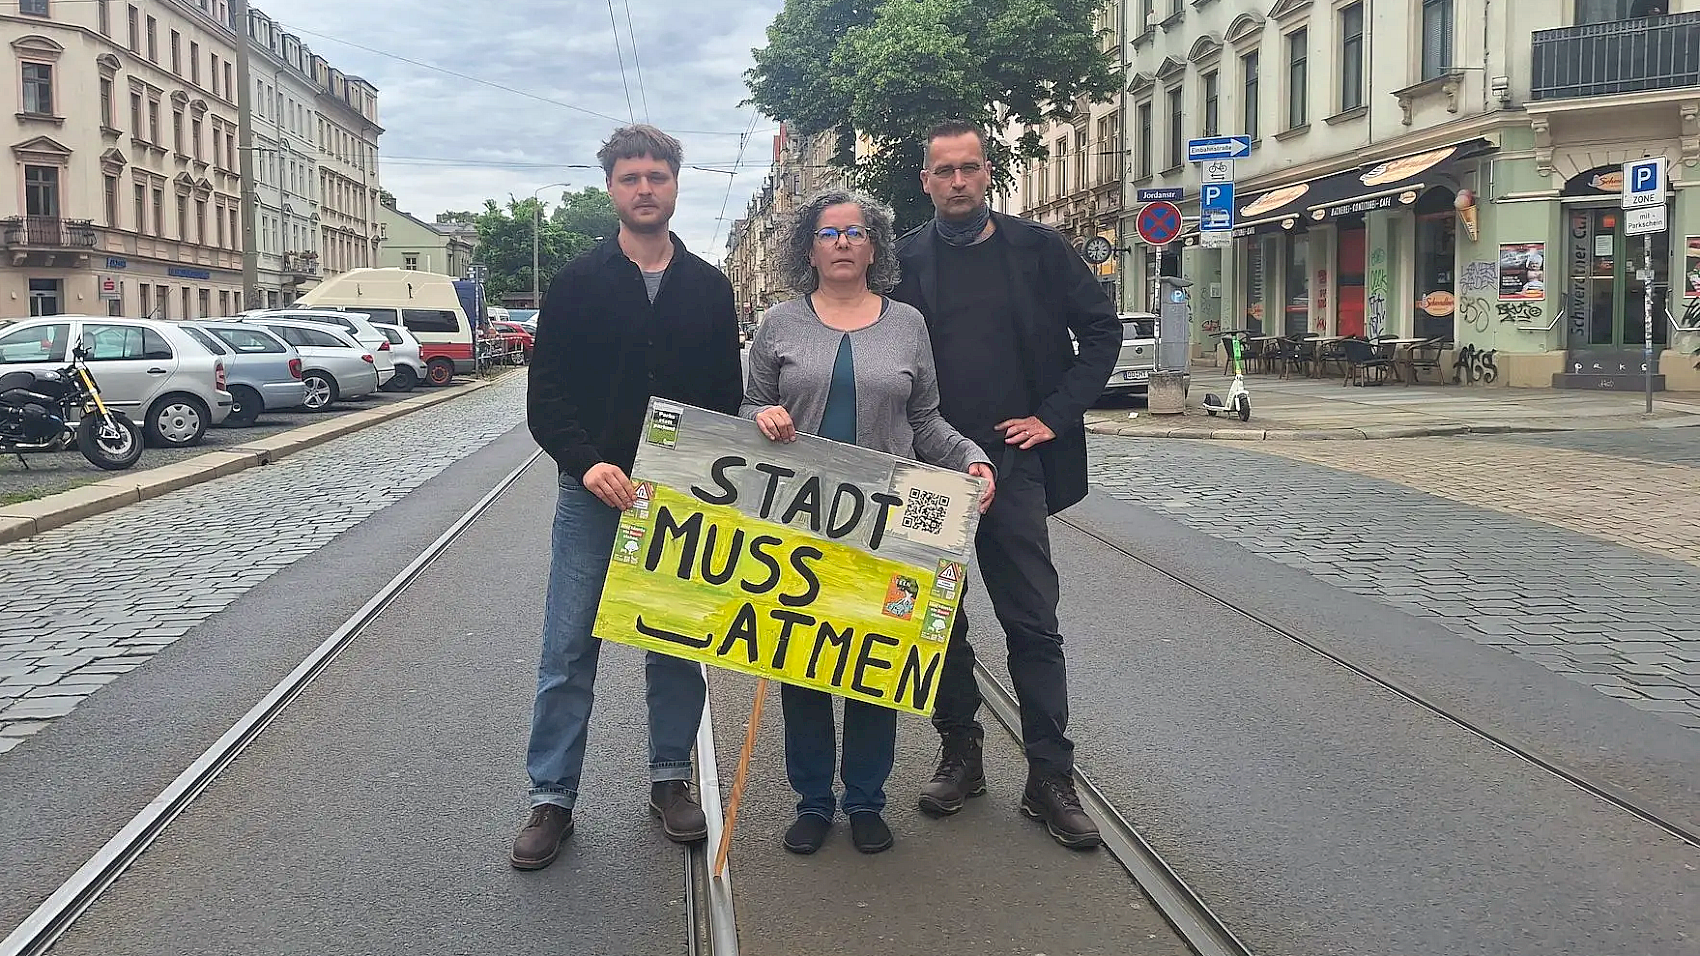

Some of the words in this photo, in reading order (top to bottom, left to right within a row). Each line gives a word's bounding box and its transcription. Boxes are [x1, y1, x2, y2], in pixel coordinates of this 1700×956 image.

[1191, 145, 1232, 154] Einbahnstraße
[1637, 167, 1652, 190] P
[1206, 186, 1221, 206] P
[1632, 194, 1656, 204] ZONE
[1628, 219, 1663, 230] Parkschein
[1639, 212, 1651, 220] mit
[690, 456, 904, 551] STADT
[644, 505, 823, 607] MUSS
[716, 603, 941, 710] ATMEN
